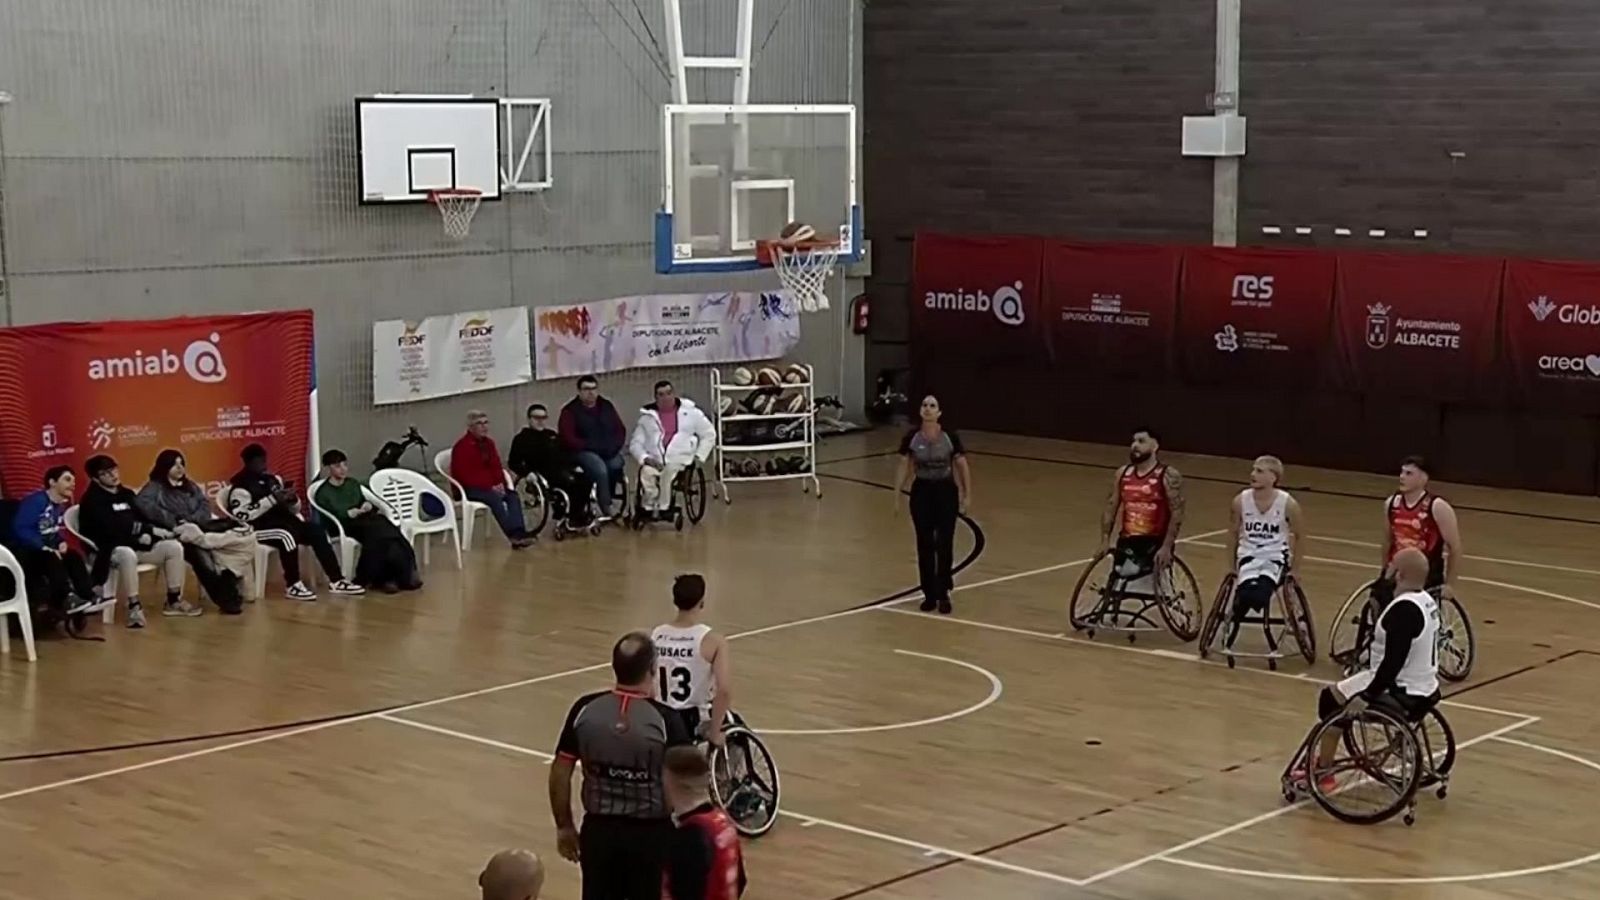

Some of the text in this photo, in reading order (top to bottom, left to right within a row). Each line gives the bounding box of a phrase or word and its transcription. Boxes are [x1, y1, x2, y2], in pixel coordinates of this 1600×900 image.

[1231, 275, 1274, 299] res
[925, 288, 990, 311] amiab
[1395, 318, 1461, 331] Ayuntamiento
[1394, 332, 1460, 348] ALBACETE
[88, 349, 180, 379] amiab
[1538, 355, 1584, 371] area
[245, 426, 286, 437] ALBACETE
[1245, 521, 1280, 534] UCAM
[659, 666, 691, 702] 13
